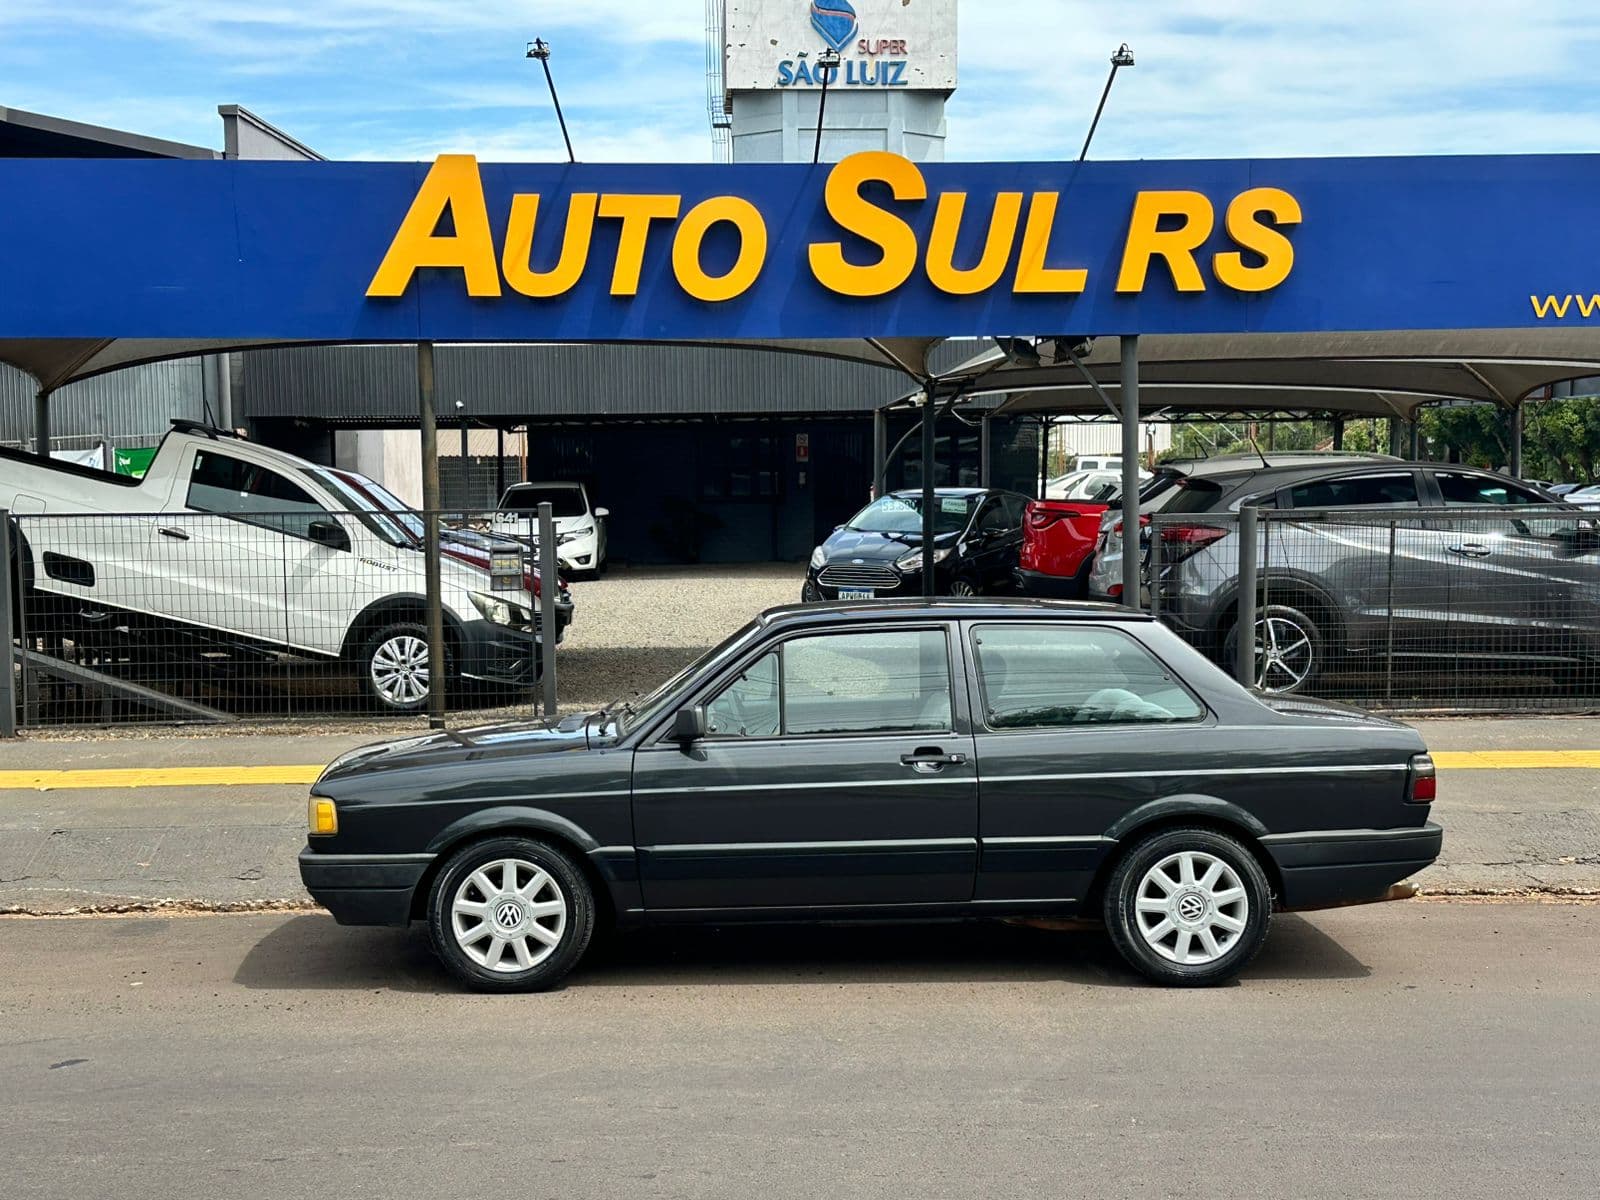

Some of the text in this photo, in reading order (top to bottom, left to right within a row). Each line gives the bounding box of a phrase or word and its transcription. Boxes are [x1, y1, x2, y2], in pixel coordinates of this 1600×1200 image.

[858, 39, 908, 55] SUPER
[778, 52, 908, 86] SÃO LUIZ
[367, 151, 1303, 301] AUTO SUL RS
